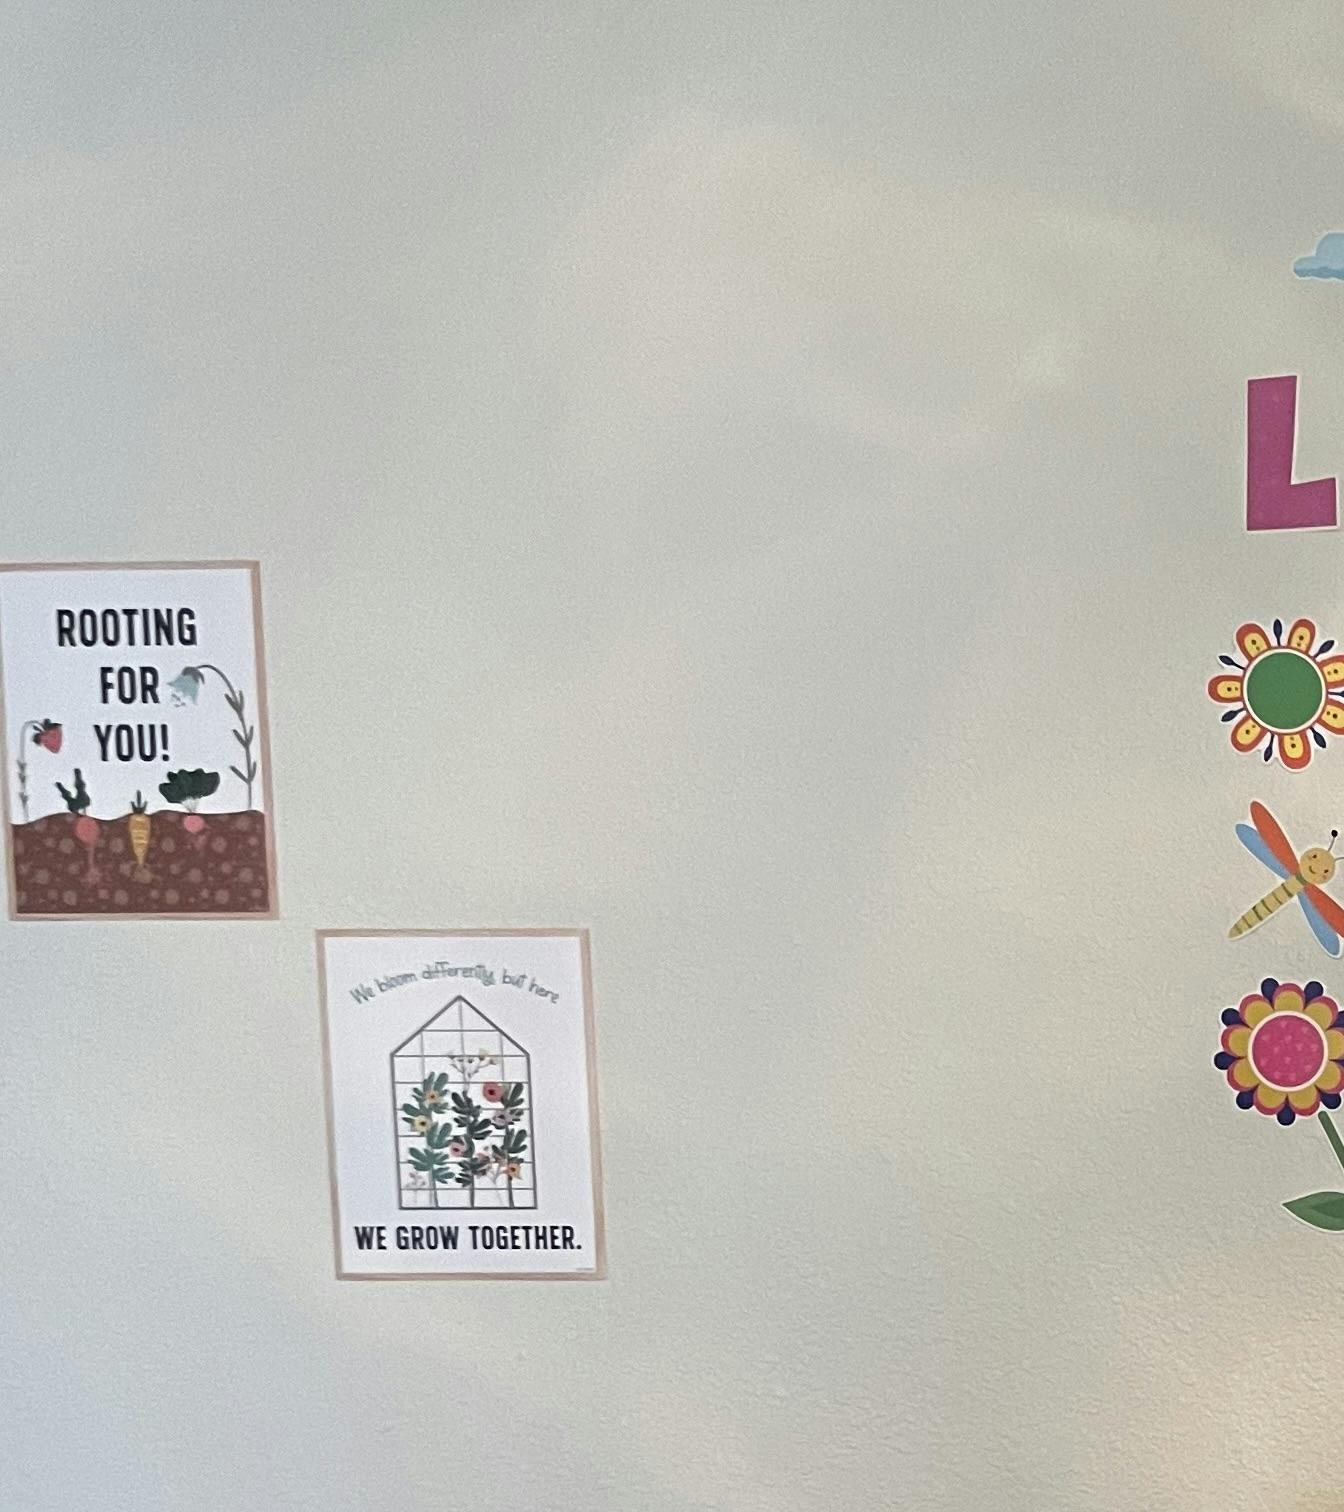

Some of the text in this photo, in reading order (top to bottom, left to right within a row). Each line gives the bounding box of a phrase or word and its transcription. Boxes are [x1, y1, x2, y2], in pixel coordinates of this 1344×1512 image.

[56, 607, 197, 647] ROOTING
[100, 666, 160, 704] FOR
[93, 724, 170, 762] YOU!
[350, 983, 376, 1004] We
[375, 972, 418, 993] bloom
[501, 968, 528, 988] but
[528, 977, 560, 1004] here
[354, 1225, 582, 1250] WE GROW TOGETHER.
